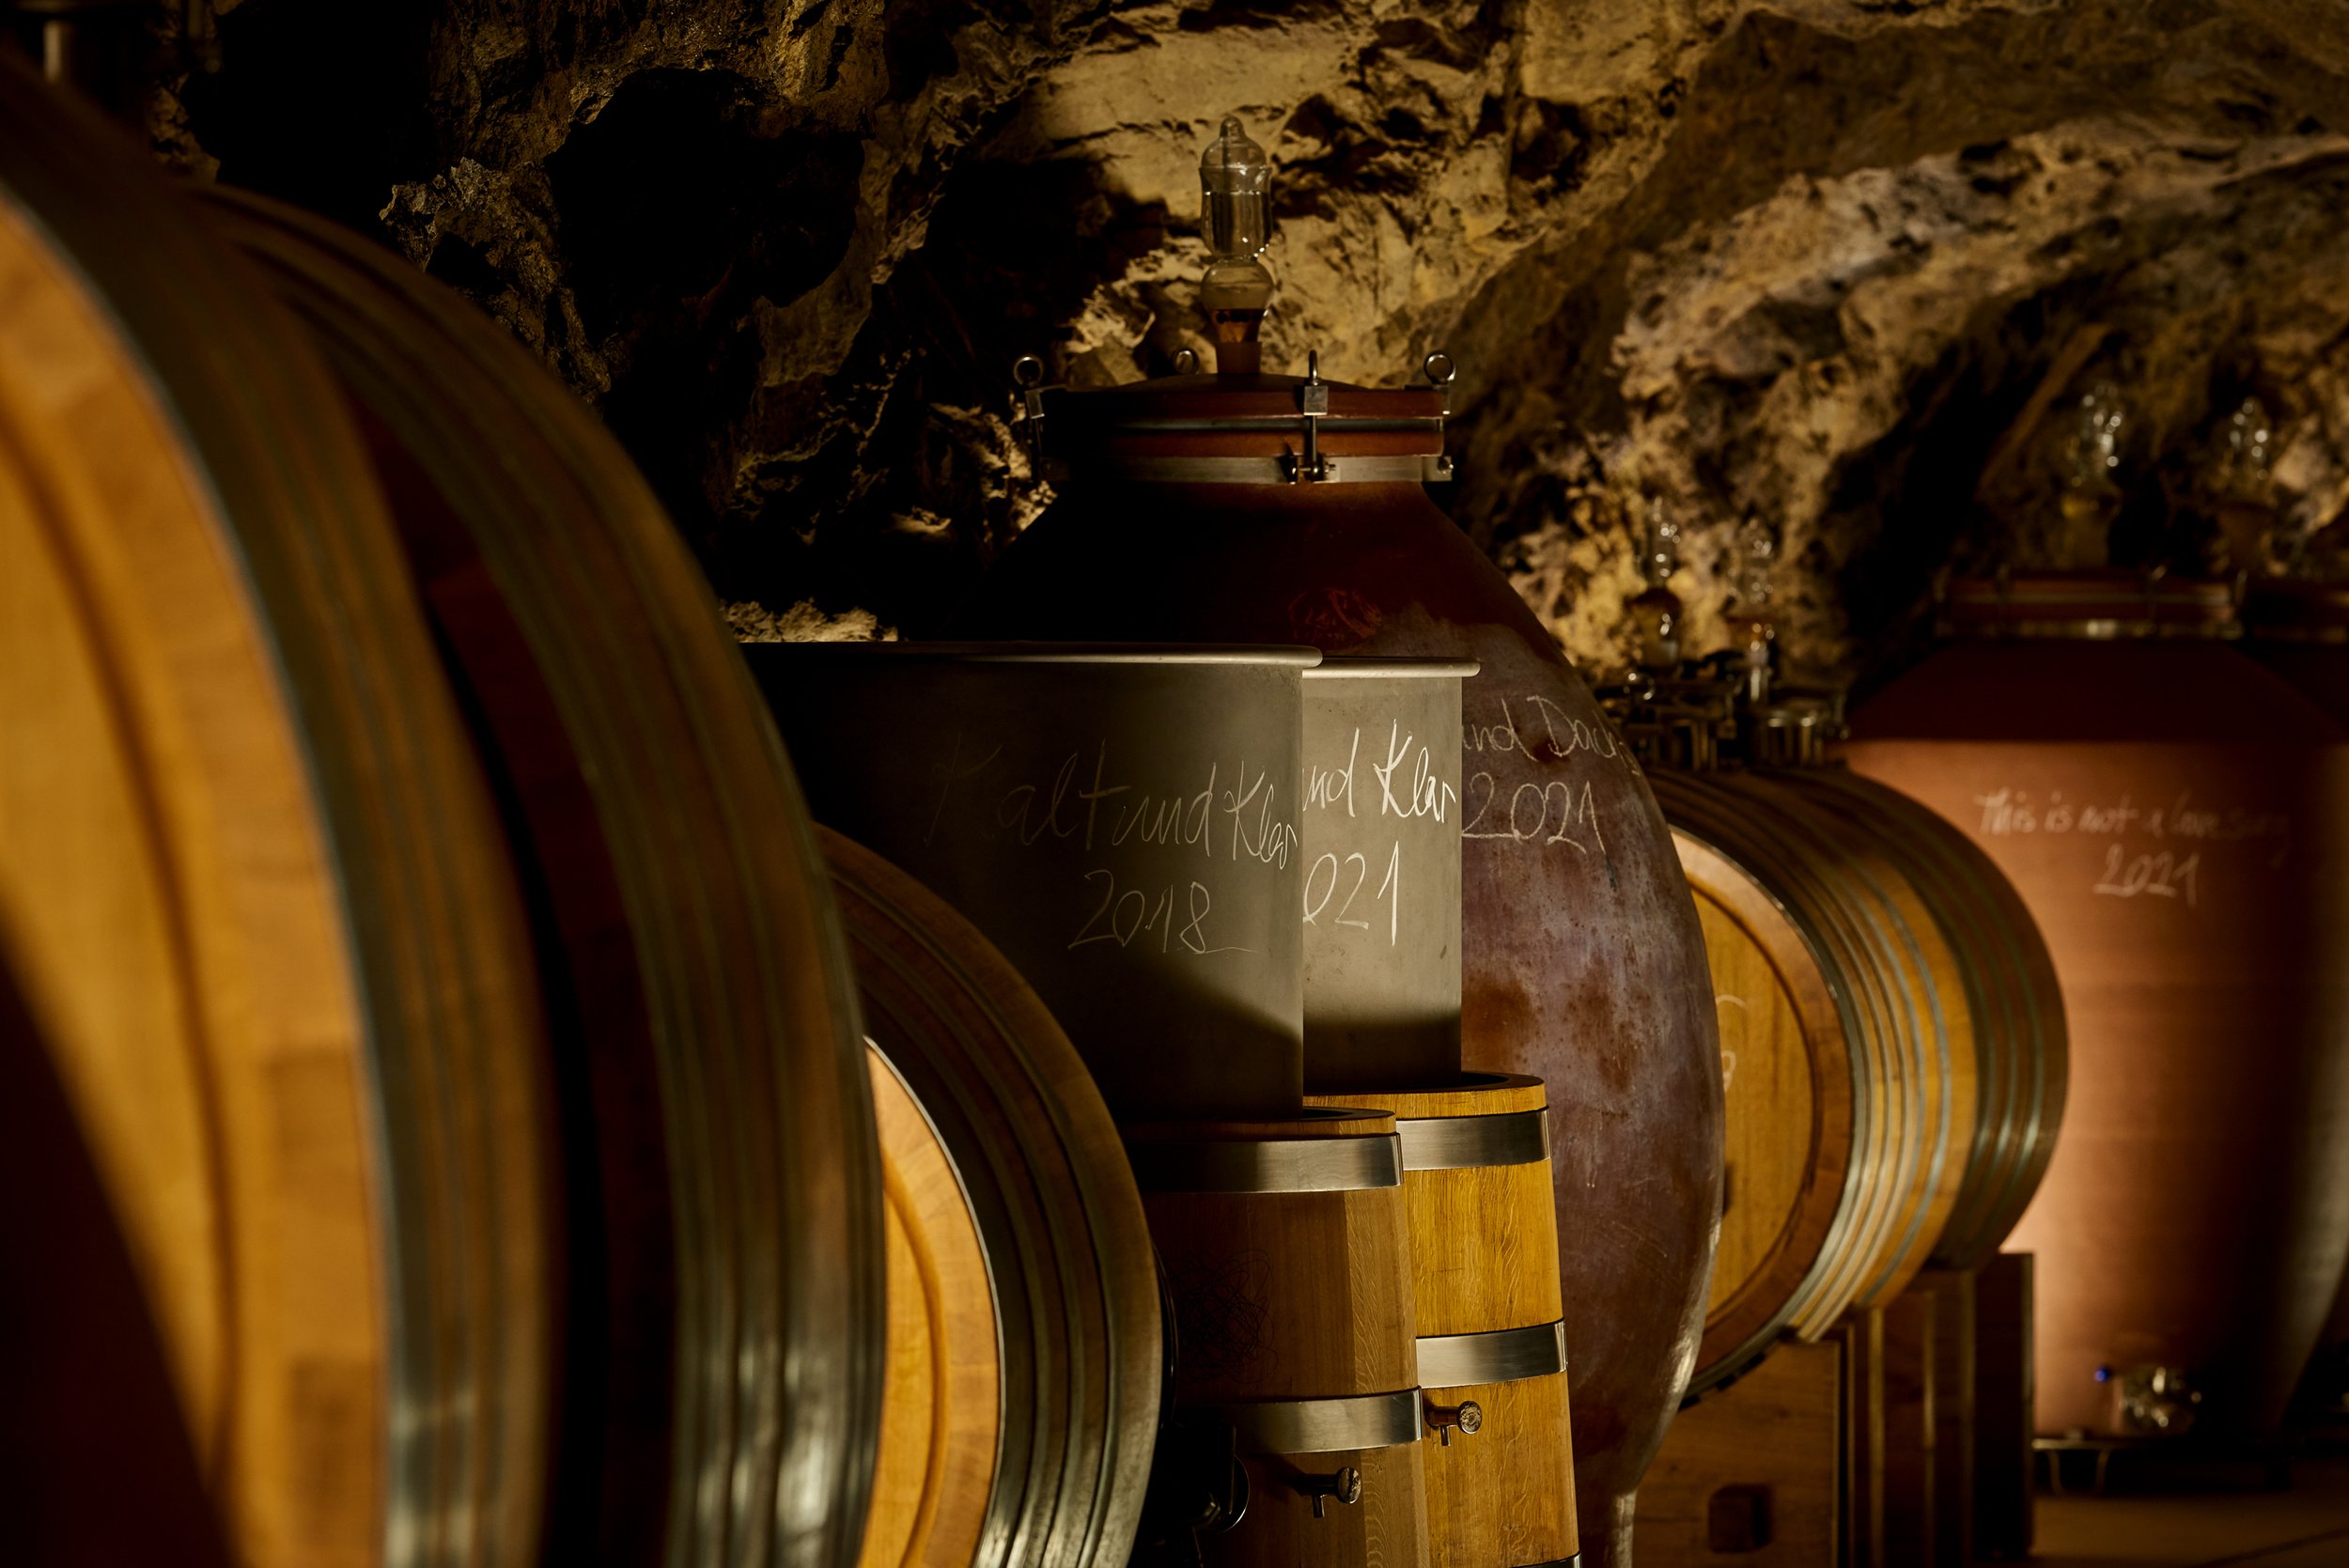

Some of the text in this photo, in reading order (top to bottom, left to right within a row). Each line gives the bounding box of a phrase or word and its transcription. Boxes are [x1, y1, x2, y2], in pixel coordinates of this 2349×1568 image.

[1303, 719, 1456, 824] nd Klar
[1462, 771, 1607, 855] 2021
[1973, 786, 2036, 835] This
[2045, 791, 2074, 832] is
[2078, 794, 2139, 834] not
[1068, 870, 1257, 955] 2018
[1303, 841, 1399, 946] 021
[2092, 844, 2200, 908] 2021
